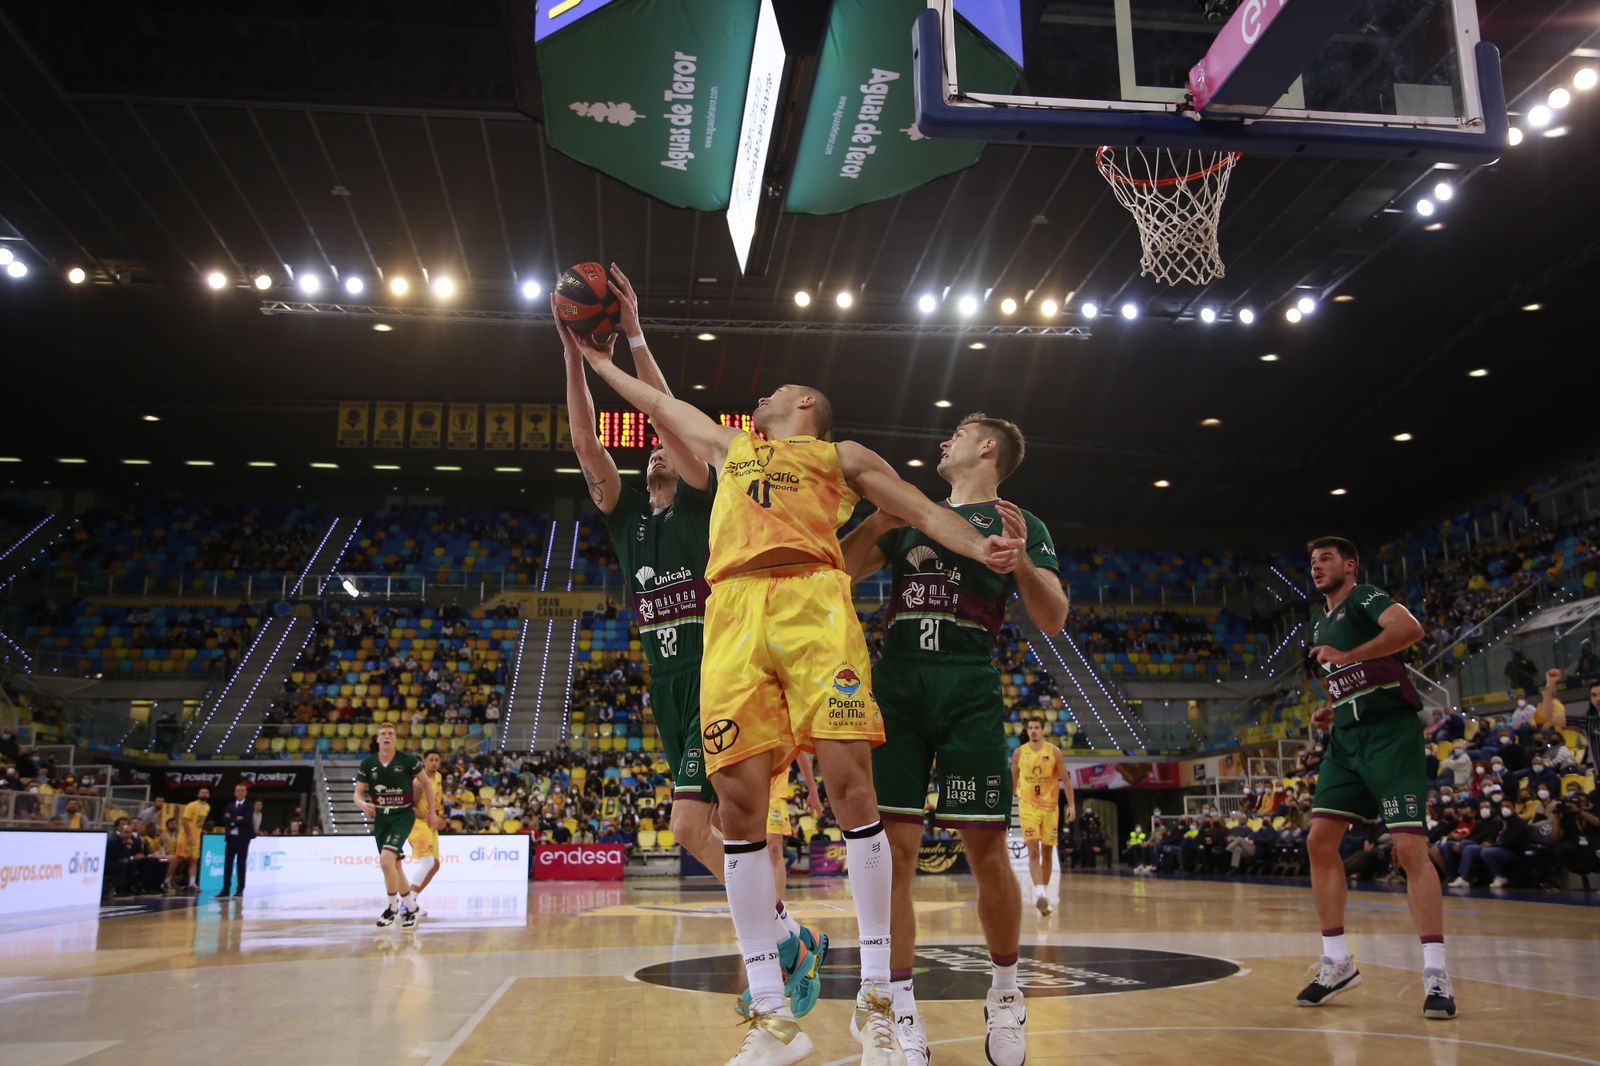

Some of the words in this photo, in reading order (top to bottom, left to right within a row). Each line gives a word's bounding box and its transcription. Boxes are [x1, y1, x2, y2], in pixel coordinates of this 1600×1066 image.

[664, 51, 698, 101] Teror
[859, 68, 900, 121] Aguas
[663, 103, 693, 126] de
[851, 122, 882, 144] de
[660, 127, 695, 171] Aguas
[840, 145, 877, 179] Teror
[654, 566, 692, 586] Unicaja
[656, 627, 678, 658] 32
[919, 618, 940, 651] 21
[829, 698, 865, 708] Poema
[829, 708, 844, 719] del
[469, 847, 520, 862] divina
[540, 848, 622, 866] endesa
[0, 864, 63, 888] guros.com
[68, 851, 100, 874] divina
